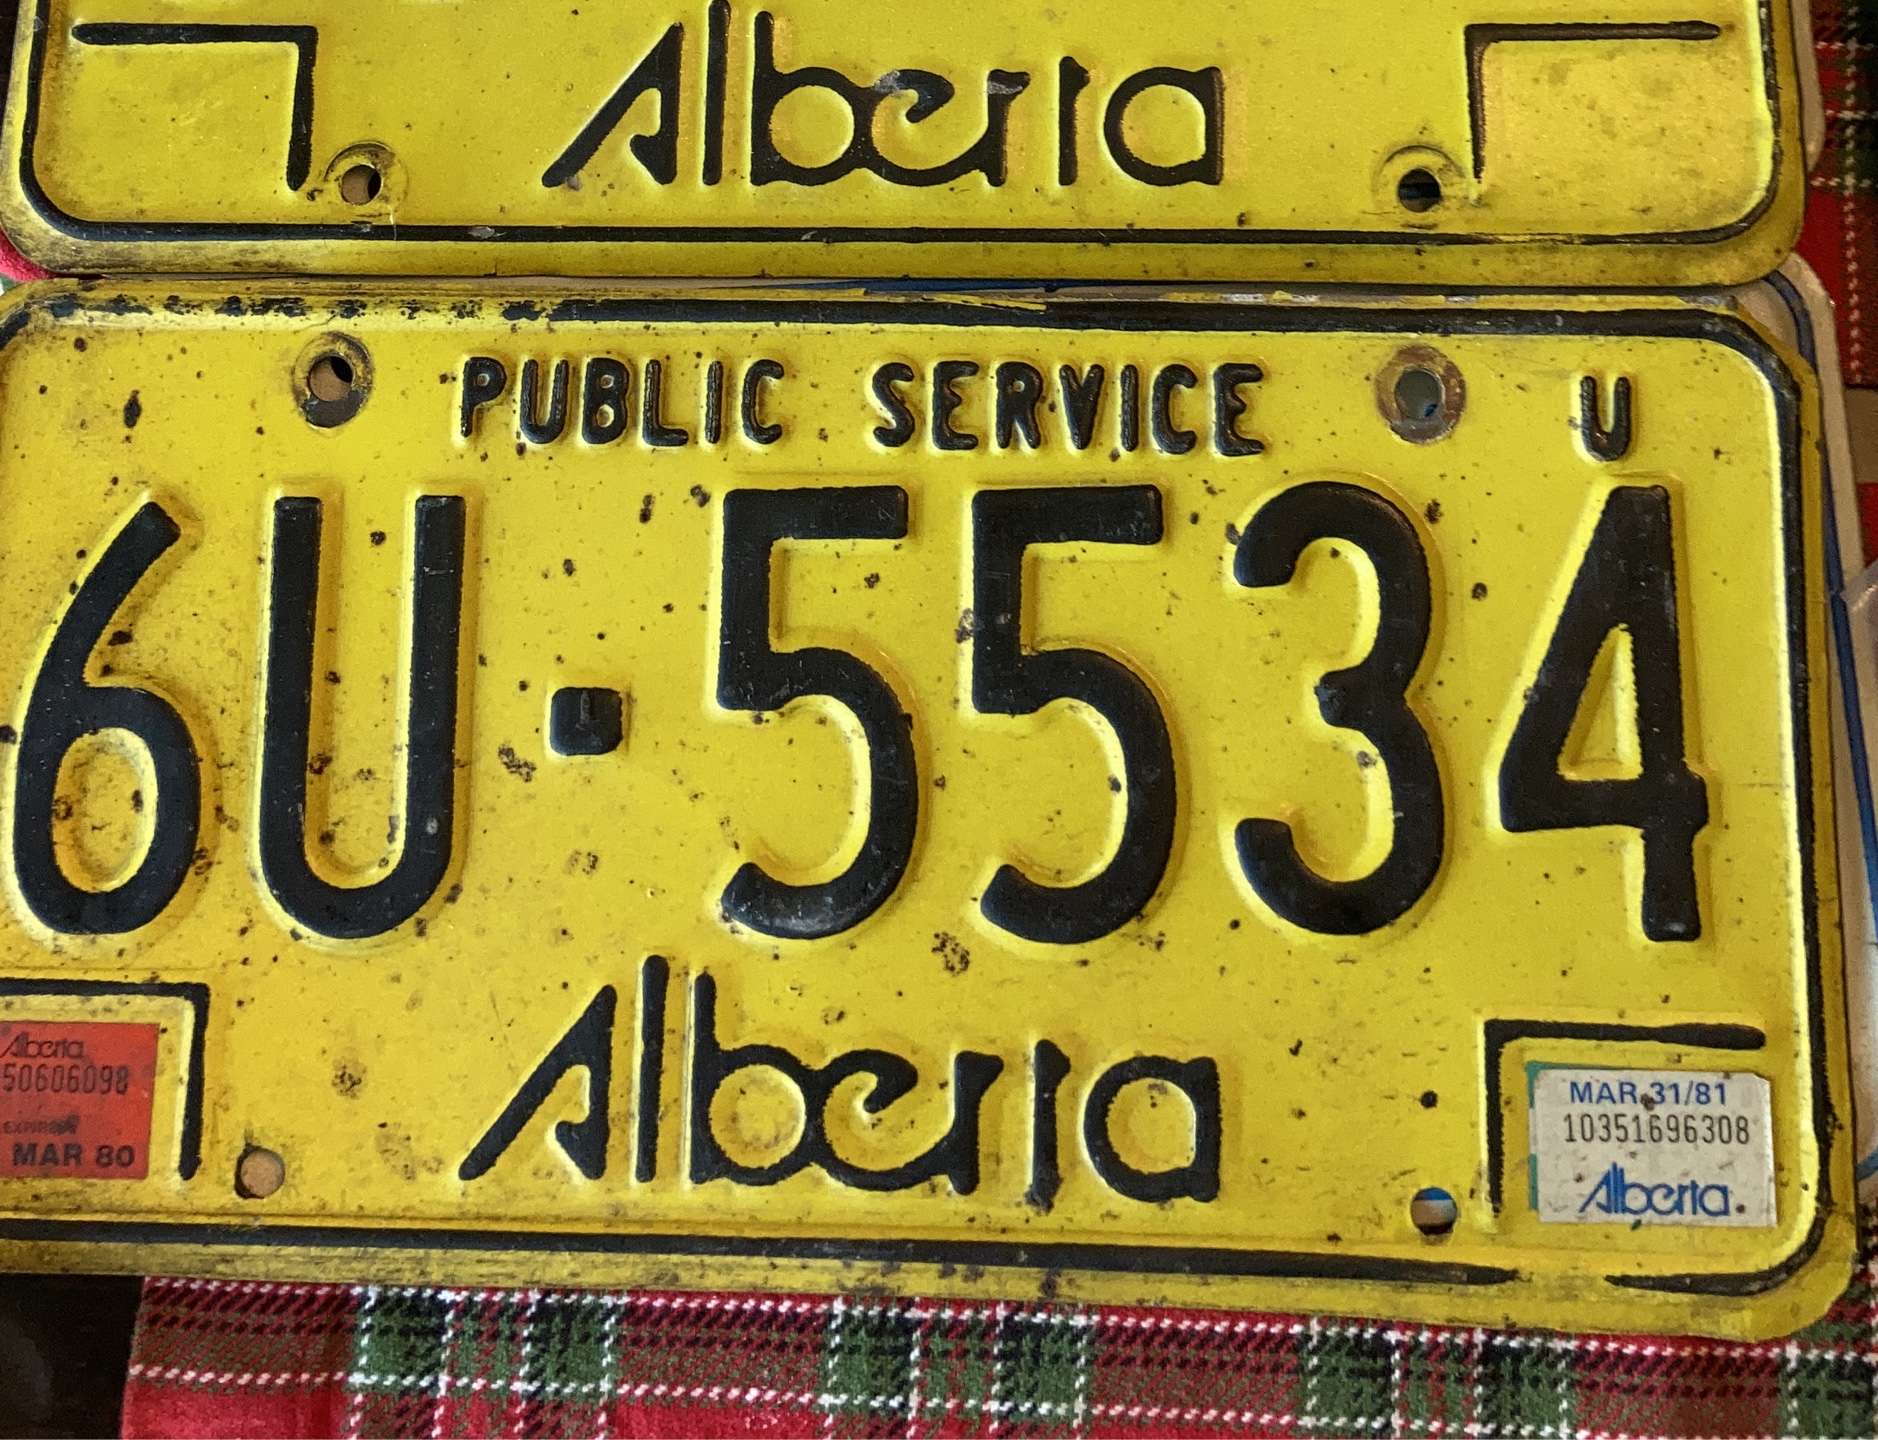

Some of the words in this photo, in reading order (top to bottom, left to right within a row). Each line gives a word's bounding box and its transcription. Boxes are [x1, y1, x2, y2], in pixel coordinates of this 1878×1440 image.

[459, 357, 784, 448] PUBLIC
[870, 360, 1266, 455] SERVICE
[1580, 375, 1632, 461] U
[457, 954, 1222, 1212] Alberta
[1569, 1081, 1638, 1105] MAR
[1650, 1080, 1727, 1107] 31/81
[12, 1142, 83, 1167] MAR
[95, 1144, 136, 1169] 80
[1563, 1113, 1750, 1145] 10351696308
[1579, 1161, 1731, 1217] Alberta
